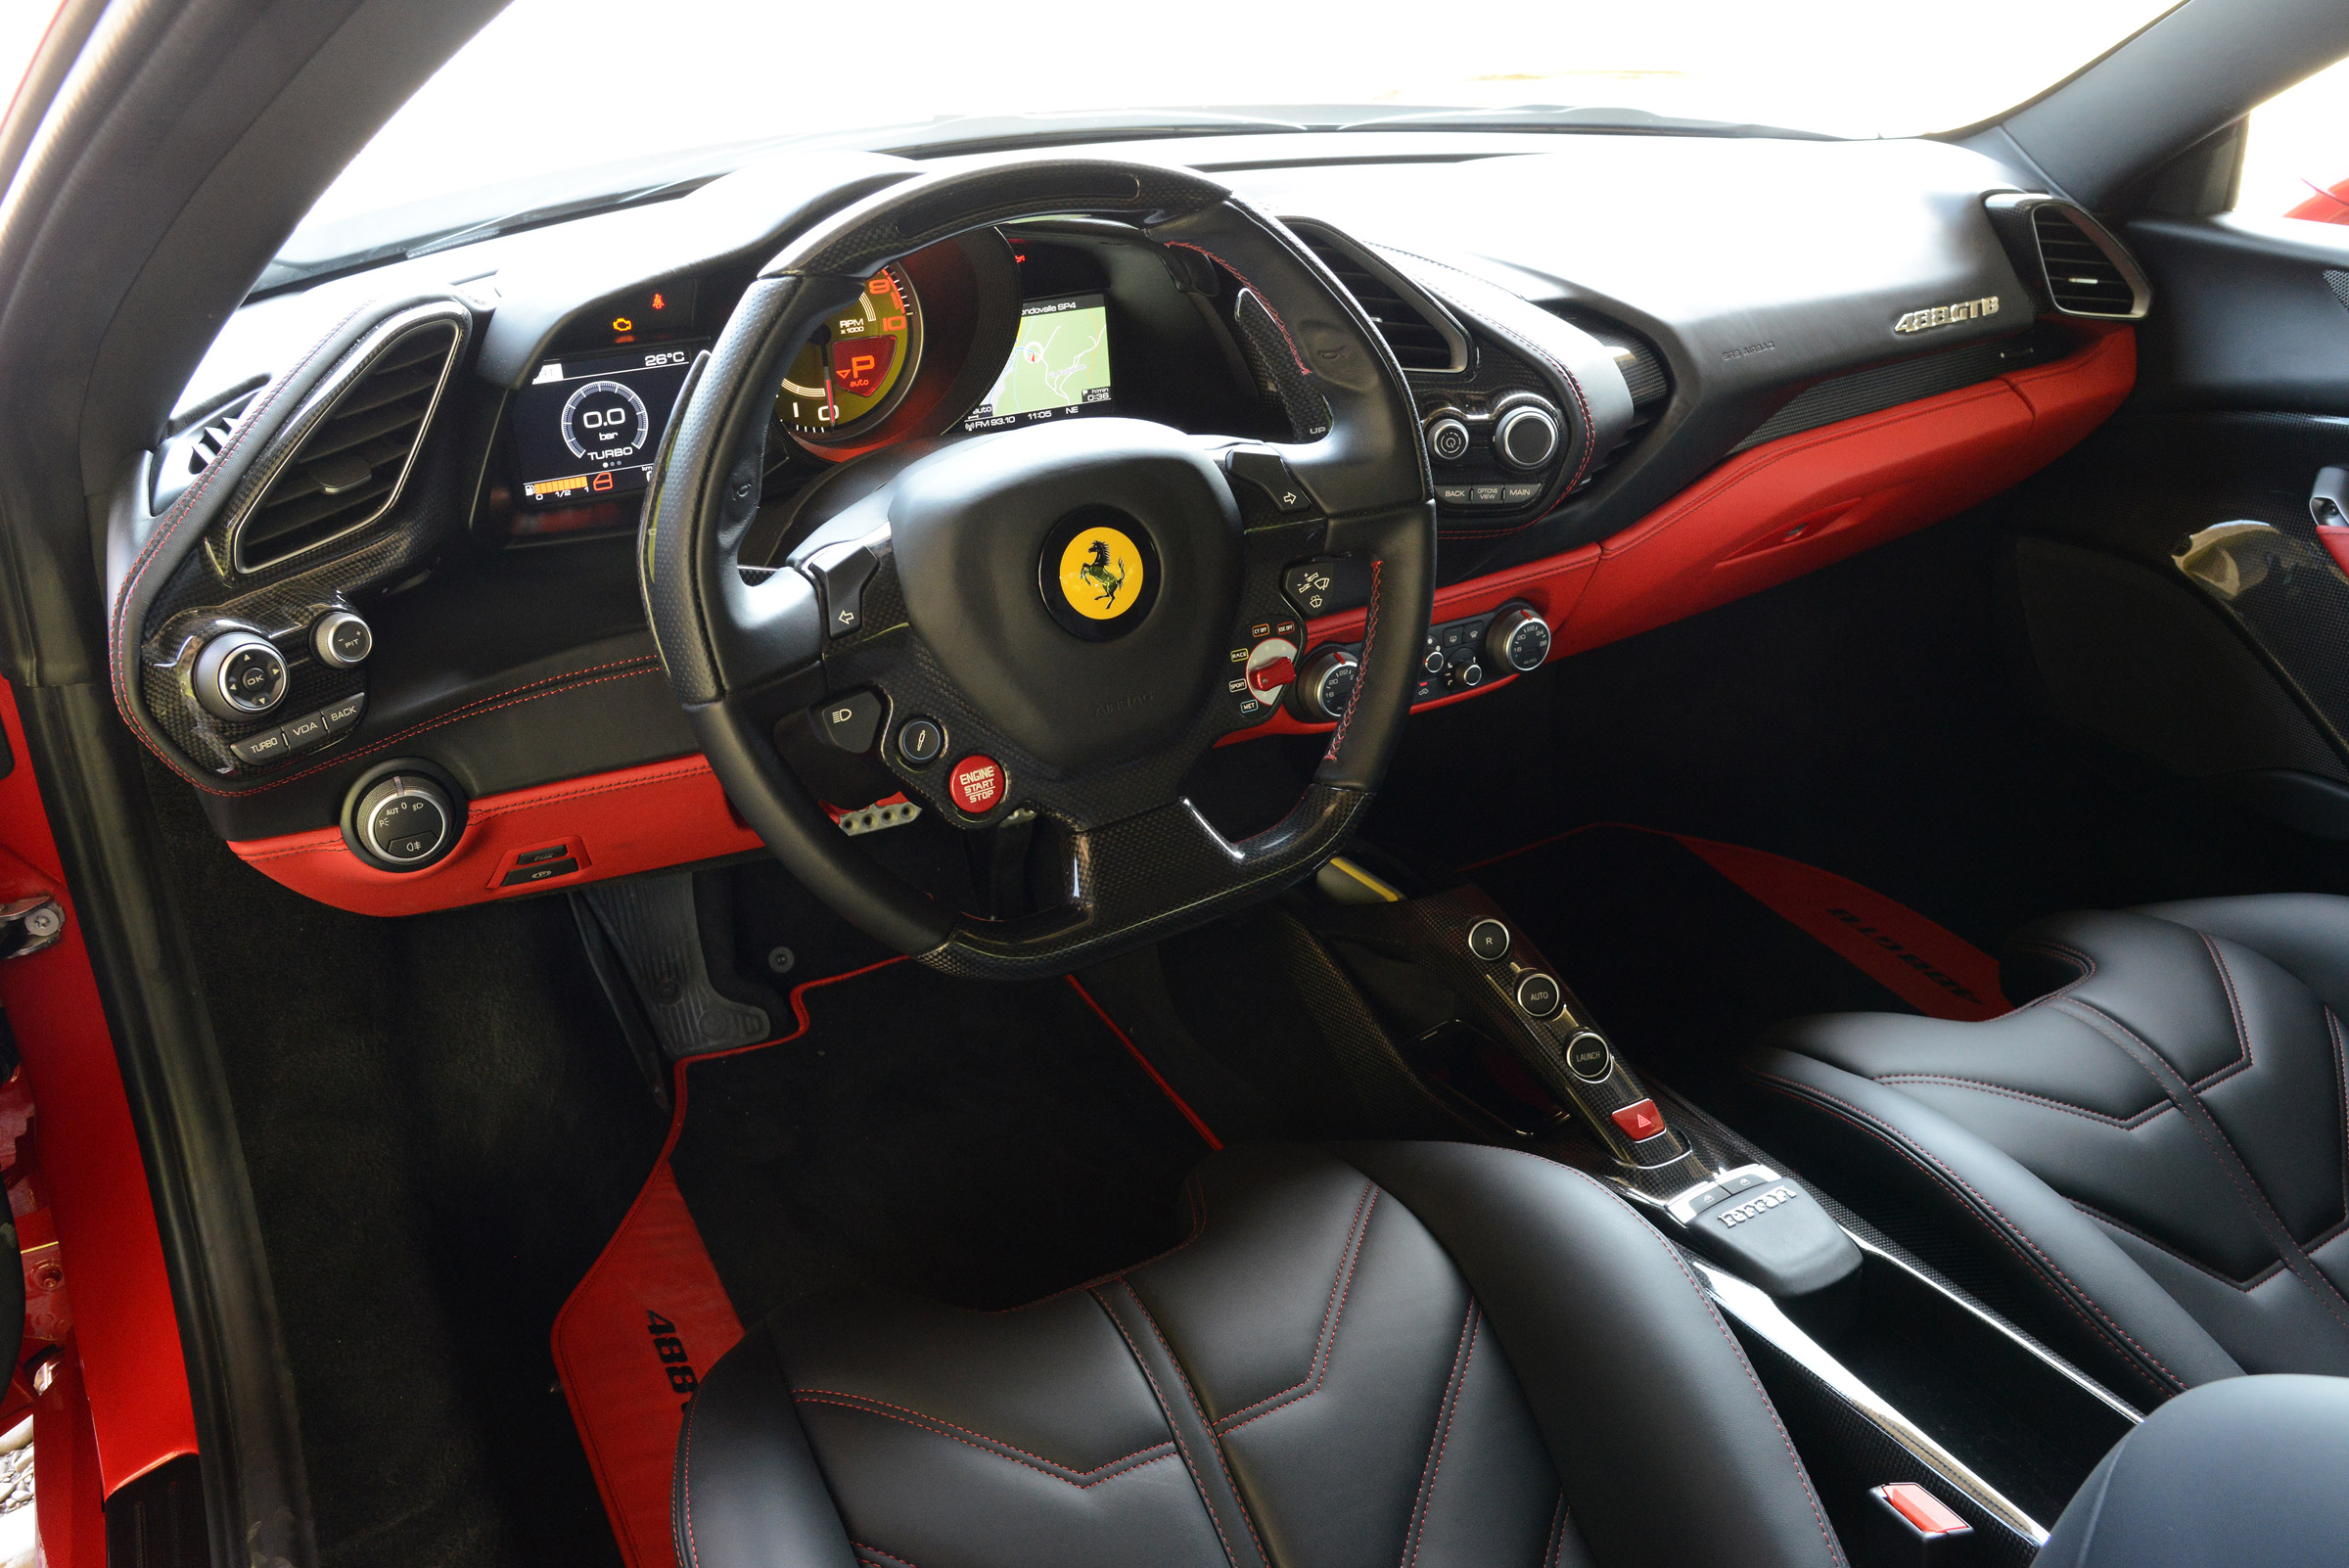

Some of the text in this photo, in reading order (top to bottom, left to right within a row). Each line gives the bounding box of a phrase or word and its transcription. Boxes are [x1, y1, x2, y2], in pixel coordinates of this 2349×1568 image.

[868, 278, 891, 295] 9
[1057, 301, 1077, 311] SP4
[840, 318, 864, 329] RPM
[846, 326, 864, 335] 1000
[883, 315, 906, 332] 10
[1743, 341, 1775, 355] AIRBAG
[645, 350, 685, 366] 26°C
[852, 354, 875, 379] P
[850, 379, 870, 388] auto
[817, 404, 839, 421] 0
[972, 405, 991, 416] auto
[1028, 410, 1052, 421] 11:05
[1065, 406, 1079, 415] NE
[583, 407, 625, 429] 0.0
[975, 415, 1016, 429] FM 93.10
[599, 431, 618, 440] bar
[1310, 426, 1326, 435] UP
[587, 446, 633, 461] TURBO
[345, 638, 359, 648] PIT
[247, 674, 264, 686] OK
[331, 705, 357, 721] BACK
[1243, 702, 1255, 711] WET
[293, 721, 319, 736] VDA
[251, 737, 278, 754] TURBO
[959, 765, 995, 786] ENGINE
[964, 778, 994, 794] START
[969, 790, 994, 804] STOP
[1486, 937, 1494, 945] R
[1531, 991, 1549, 1002] AUTO
[1576, 1050, 1601, 1063] LAUNCH
[1717, 1185, 1797, 1228] Ferrari
